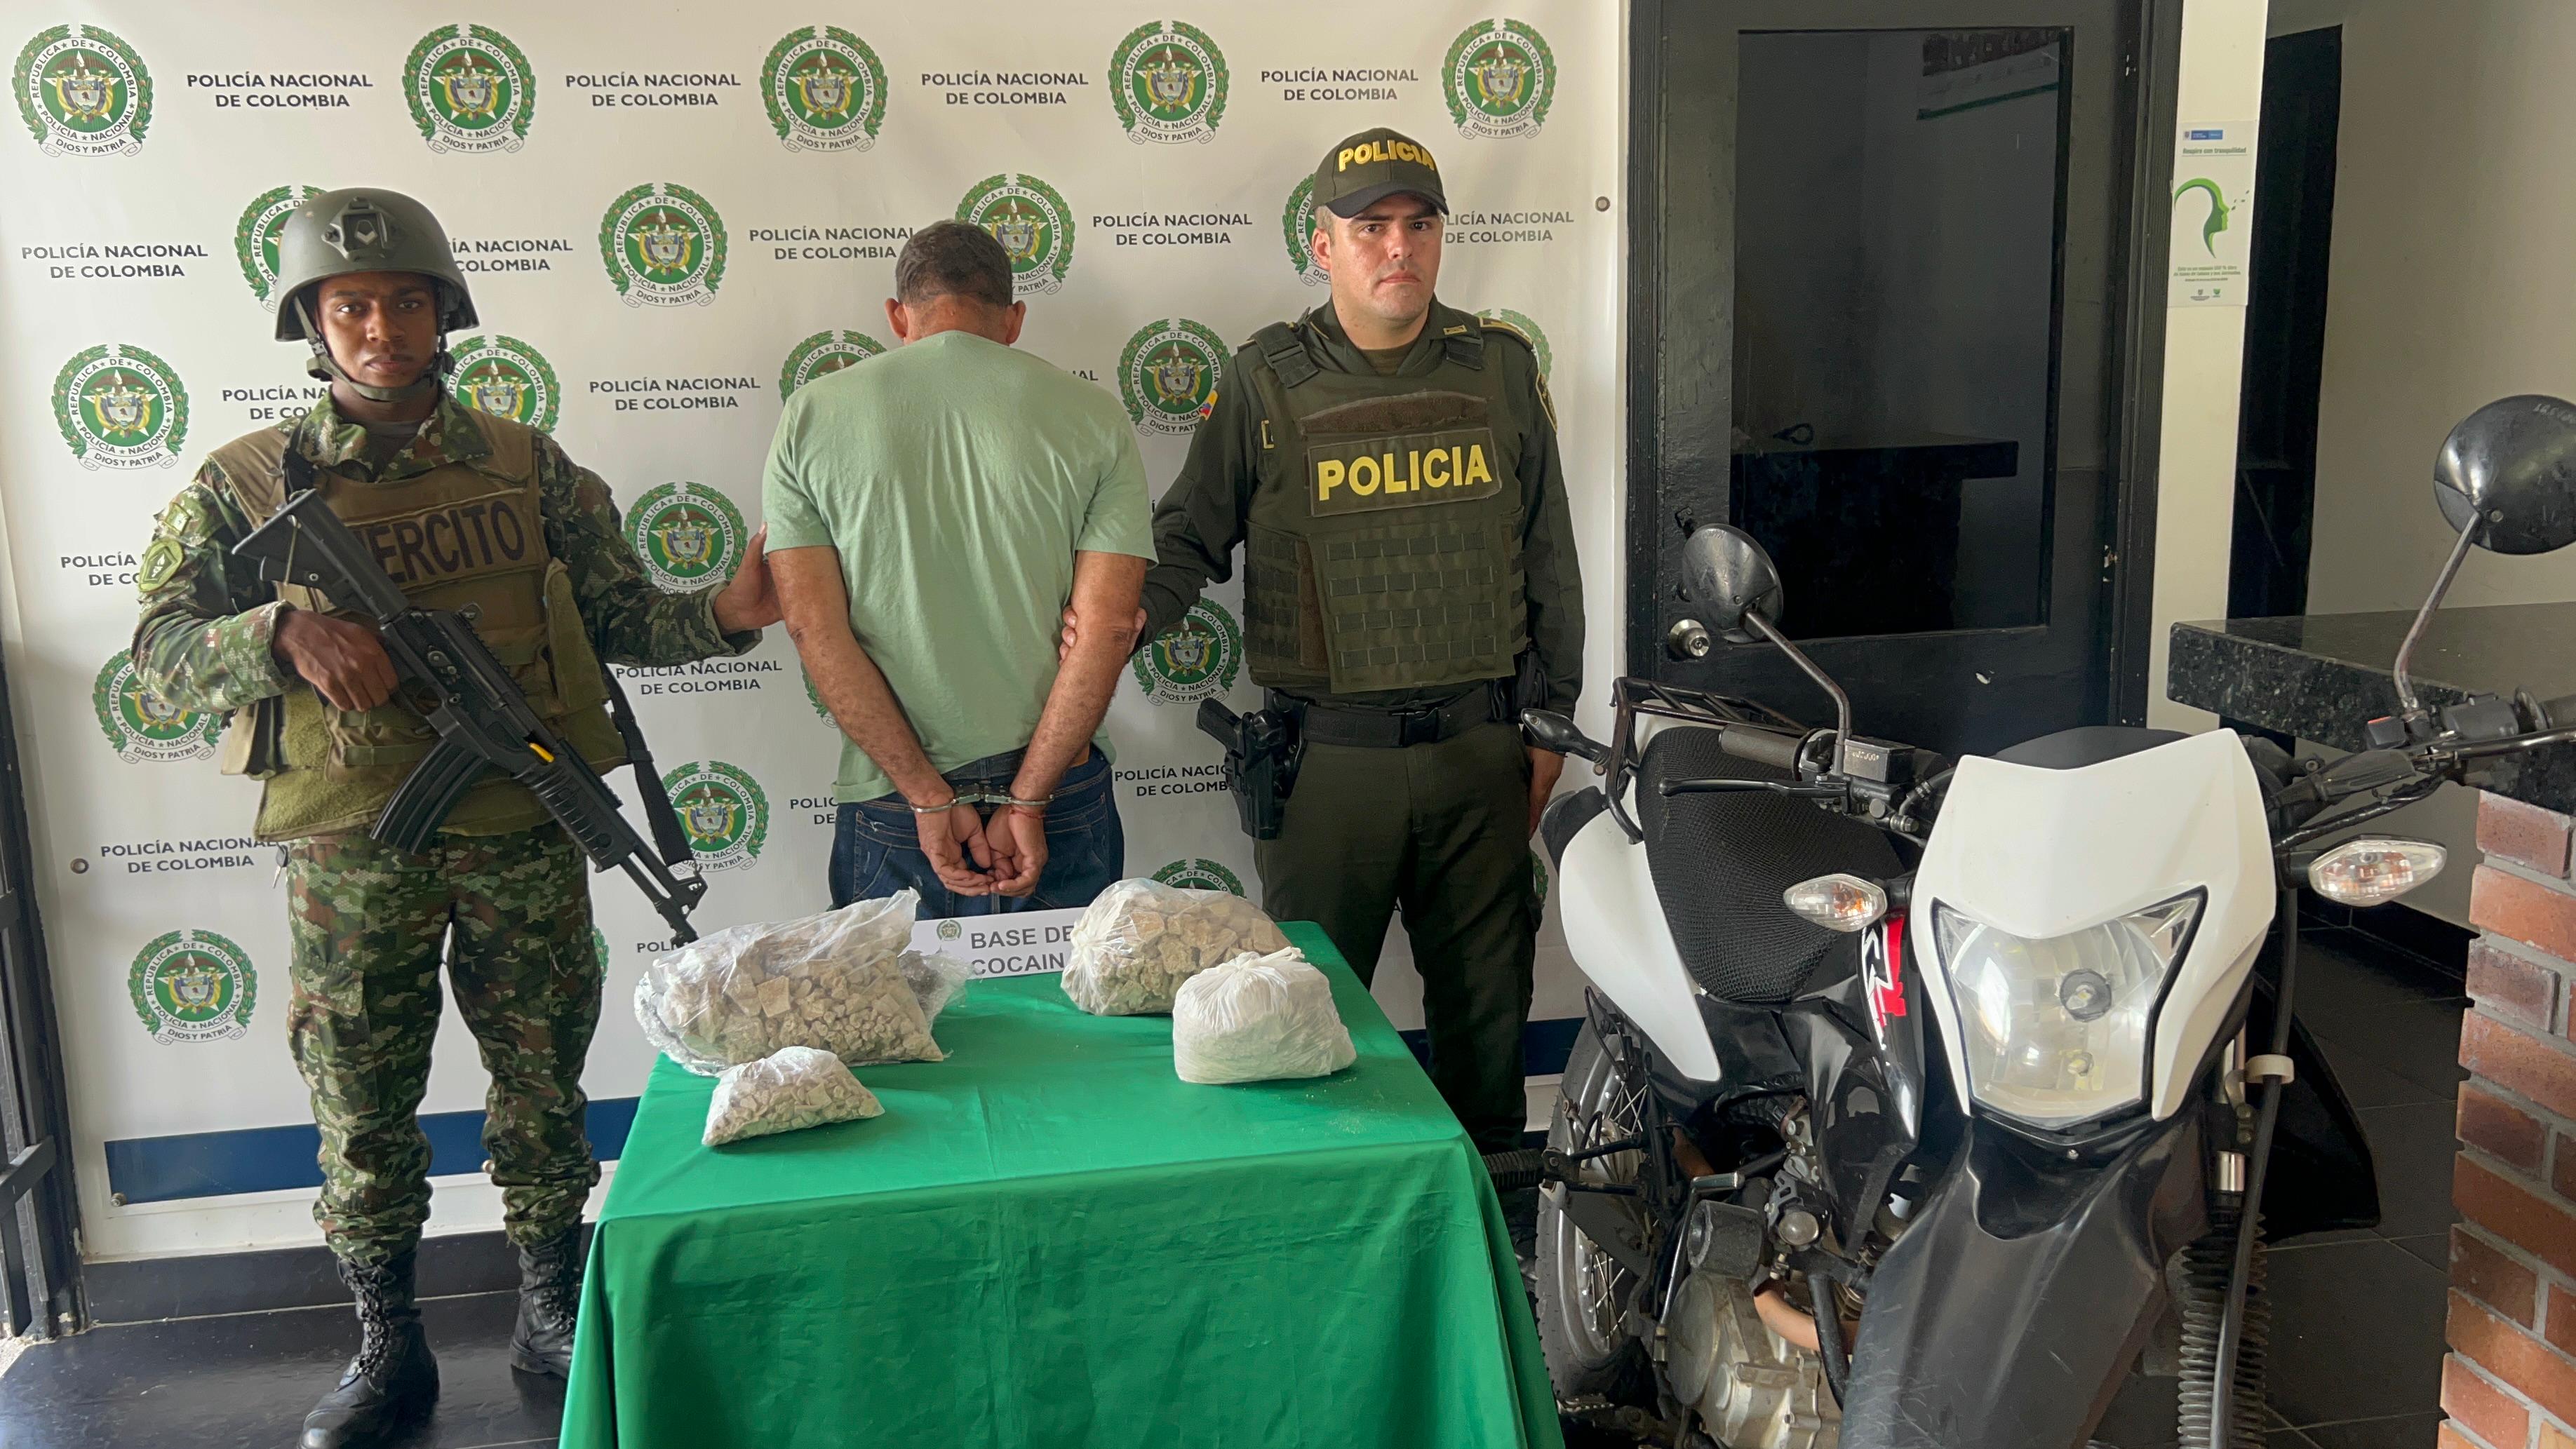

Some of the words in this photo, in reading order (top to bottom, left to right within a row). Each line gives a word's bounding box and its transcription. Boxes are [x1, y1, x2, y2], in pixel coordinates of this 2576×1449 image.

[1185, 41, 1214, 89] COLOMBIA
[1516, 38, 1542, 85] COLOMBIA
[98, 46, 136, 97] COLOMBIA
[485, 45, 520, 96] COLOMBIA
[840, 46, 872, 96] COLOMBIA
[922, 70, 992, 86] POLICÍA
[997, 73, 1088, 85] NACIONAL
[1261, 67, 1327, 82] POLICÍA
[1333, 69, 1418, 81] NACIONAL
[187, 72, 265, 87] POLICÍA
[271, 74, 373, 87] NACIONAL
[566, 72, 639, 87] POLICÍA
[645, 74, 741, 86] NACIONAL
[216, 95, 241, 107] DE
[246, 95, 349, 107] COLOMBIA
[592, 95, 615, 106] DE
[622, 94, 718, 106] COLOMBIA
[946, 93, 968, 104] DE
[974, 93, 1066, 104] COLOMBIA
[1284, 89, 1305, 100] DE
[1310, 88, 1397, 100] COLOMBIA
[1172, 101, 1211, 129] NACIONAL
[1501, 96, 1538, 124] NACIONAL
[90, 111, 133, 141] NACIONAL
[476, 109, 517, 137] NACIONAL
[829, 108, 869, 137] NACIONAL
[1472, 122, 1491, 135] DIOS
[1501, 122, 1529, 135] PATRIA
[797, 135, 819, 148] DIOS
[829, 135, 861, 149] PATRIA
[1141, 127, 1162, 140] DIOS
[1172, 127, 1202, 141] PATRIA
[56, 138, 81, 152] DIOS
[92, 138, 126, 154] PATRIA
[443, 135, 466, 149] DIOS
[476, 135, 509, 150] PATRIA
[1339, 140, 1435, 172] POLICIA
[1031, 193, 1060, 241] COLOMBIA
[1093, 212, 1160, 227] POLICÍA
[1165, 214, 1252, 226] NACIONAL
[1445, 211, 1486, 225] LICÍA
[1491, 212, 1574, 224] NACIONAL
[679, 203, 712, 251] COLOMBIA
[750, 226, 820, 241] POLICÍA
[1117, 234, 1137, 245] DE
[1143, 233, 1230, 245] COLOMBIA
[1445, 232, 1465, 243] DE
[1470, 230, 1552, 243] COLOMBIA
[22, 243, 100, 259] POLICÍA
[105, 245, 208, 257] NACIONAL
[476, 239, 573, 252] NACIONAL
[774, 248, 797, 260] DE
[803, 247, 897, 259] COLOMBIA
[51, 267, 74, 278] DE
[81, 265, 185, 278] COLOMBIA
[1018, 252, 1056, 281] NACIONAL
[669, 263, 709, 292] NACIONAL
[1018, 278, 1048, 292] PATRIA
[636, 290, 659, 303] DIOS
[669, 290, 701, 304] PATRIA
[1192, 337, 1220, 383] COLOMBIA
[511, 354, 544, 402] COLOMBIA
[590, 377, 661, 393] POLICÍA
[666, 377, 760, 390] NACIONAL
[136, 364, 173, 413] COLOMBIA
[223, 385, 297, 401] POLICÍA
[616, 399, 638, 410] DE
[644, 396, 738, 410] COLOMBIA
[250, 408, 274, 419] DE
[1149, 419, 1169, 431] DIOS
[128, 425, 170, 454] NACIONAL
[94, 452, 119, 466] DIOS
[129, 452, 163, 466] PATRIA
[1317, 444, 1492, 501] POLICIA
[701, 500, 732, 546] COLOMBIA
[354, 501, 525, 584] ERCITO
[61, 551, 137, 568] POLICÍA
[690, 557, 730, 585] NACIONAL
[89, 574, 113, 586] DE
[1202, 612, 1228, 654] COLOMBIA
[691, 661, 783, 675] NACIONAL
[1188, 664, 1225, 691] NACIONAL
[641, 683, 663, 694] DE
[669, 679, 760, 693] COLOMBIA
[1160, 690, 1179, 701] DIOS
[1188, 688, 1216, 701] PATRIA
[167, 718, 208, 748] NACIONAL
[134, 746, 157, 758] DIOS
[168, 744, 200, 759] PATRIA
[1115, 765, 1177, 781] POLICÍA
[1136, 786, 1156, 796] DE
[1161, 781, 1227, 795] COLOMB
[723, 778, 754, 821] COLOMBIA
[790, 797, 838, 809] POLIC
[814, 814, 834, 825] DE
[101, 840, 174, 857] POLICÍA
[713, 831, 751, 858] NACIONAL
[128, 862, 152, 872] DE
[156, 855, 254, 871] COLOMBIA
[713, 855, 743, 869] PATRIA
[971, 928, 1037, 949] BASE
[1045, 926, 1074, 943] DE
[208, 946, 241, 990] COLOMBIA
[972, 952, 1065, 976] COCAIN
[199, 1000, 239, 1029] NACIONAL
[168, 1028, 190, 1039] DIOS
[201, 1025, 232, 1039] PATRIA
